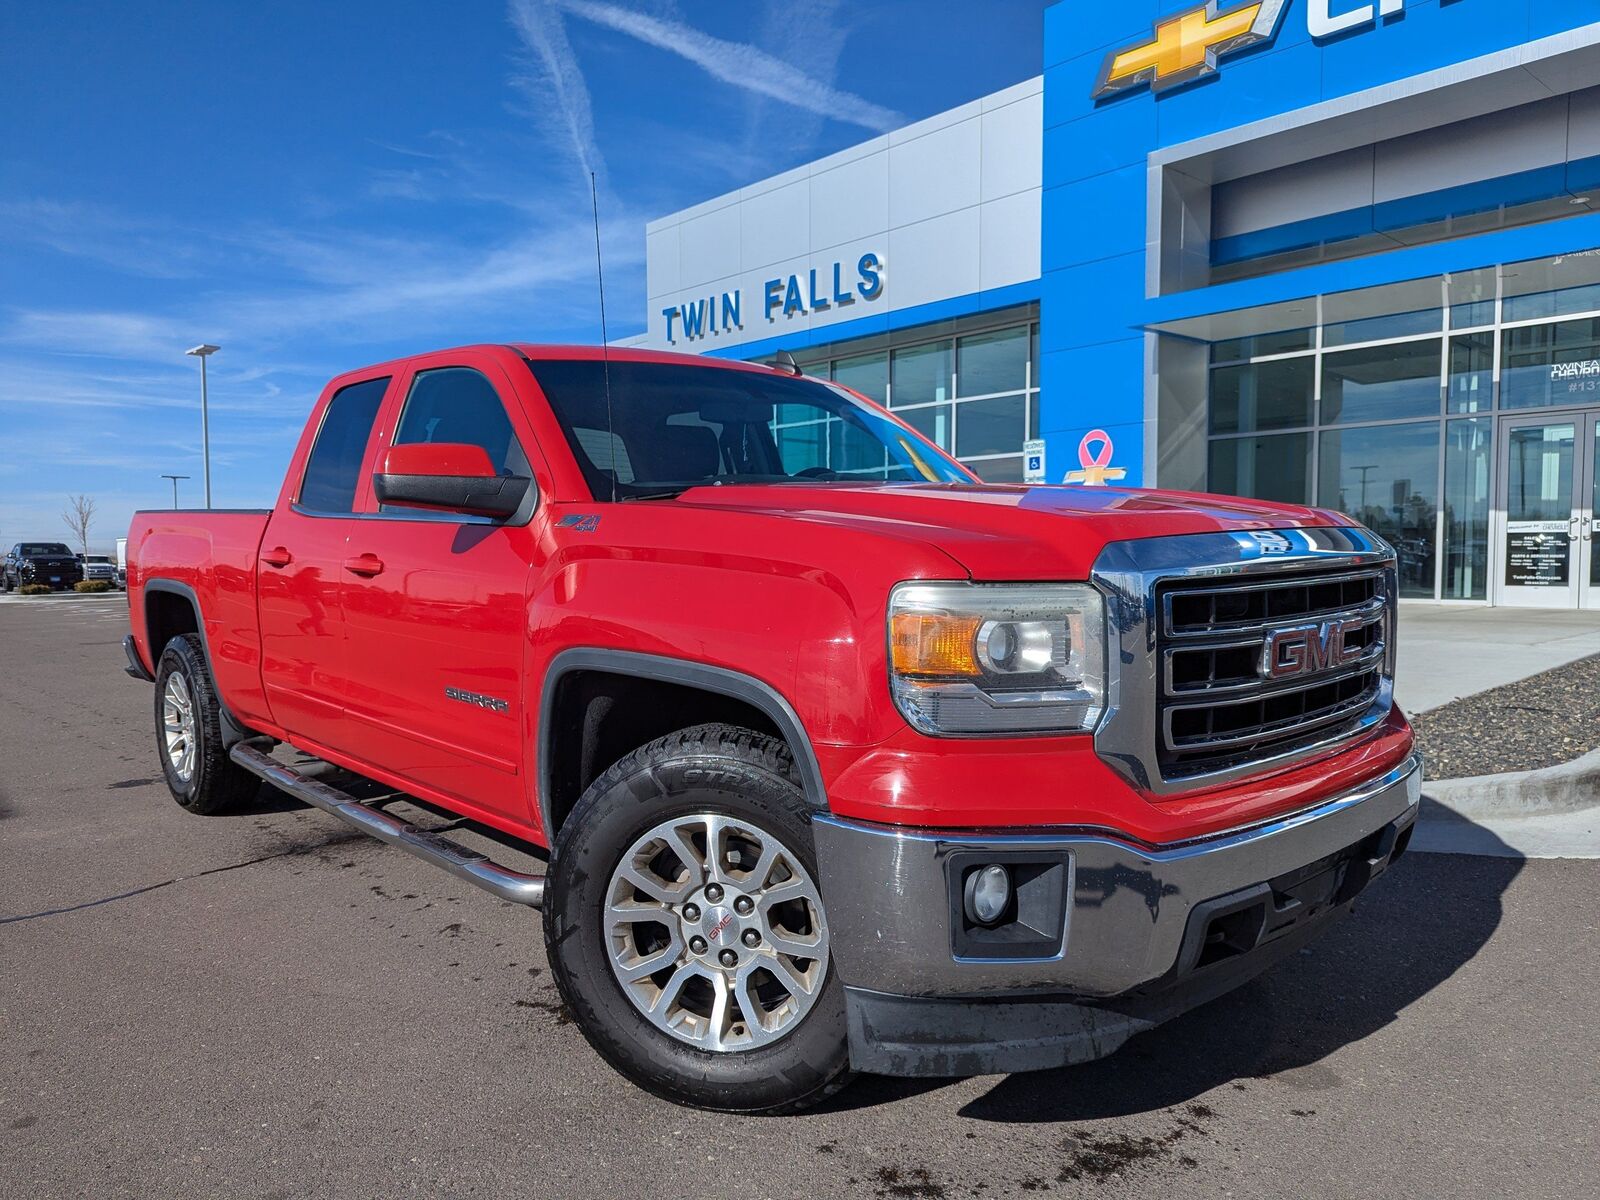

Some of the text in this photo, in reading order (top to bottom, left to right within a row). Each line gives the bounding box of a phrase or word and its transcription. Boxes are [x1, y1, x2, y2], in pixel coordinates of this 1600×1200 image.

[662, 253, 884, 344] TWIN FALLS
[1263, 617, 1363, 680] GMC
[445, 686, 509, 713] SIERRA
[708, 913, 733, 940] GMC
